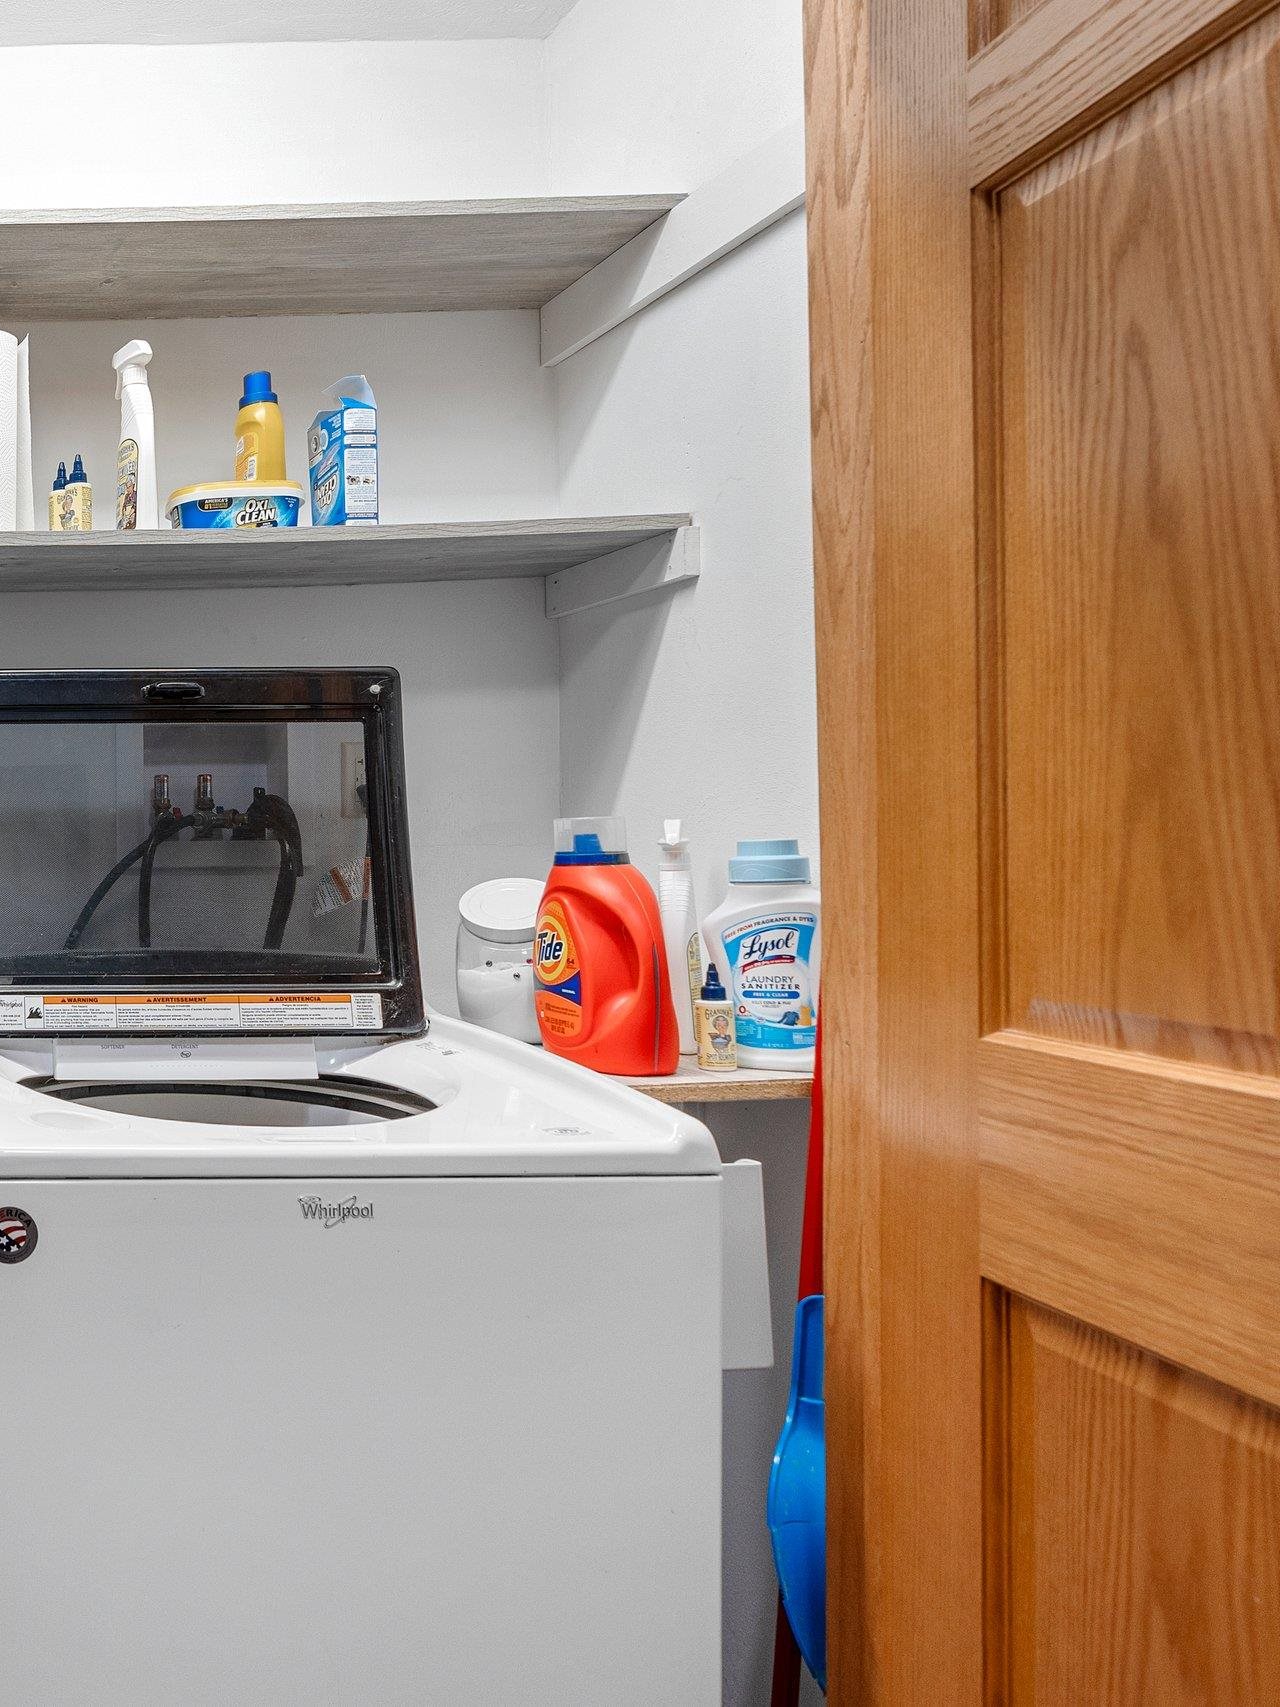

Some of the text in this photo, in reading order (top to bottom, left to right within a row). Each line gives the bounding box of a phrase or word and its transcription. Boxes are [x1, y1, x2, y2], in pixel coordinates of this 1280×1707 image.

[245, 498, 269, 513] OXI
[236, 507, 276, 526] CLEAN
[753, 916, 792, 928] FRAGRANCE
[538, 931, 564, 966] Tide
[742, 930, 795, 960] Lysol
[746, 976, 795, 984] LAUNDRY
[300, 1201, 374, 1224] Whirlpool
